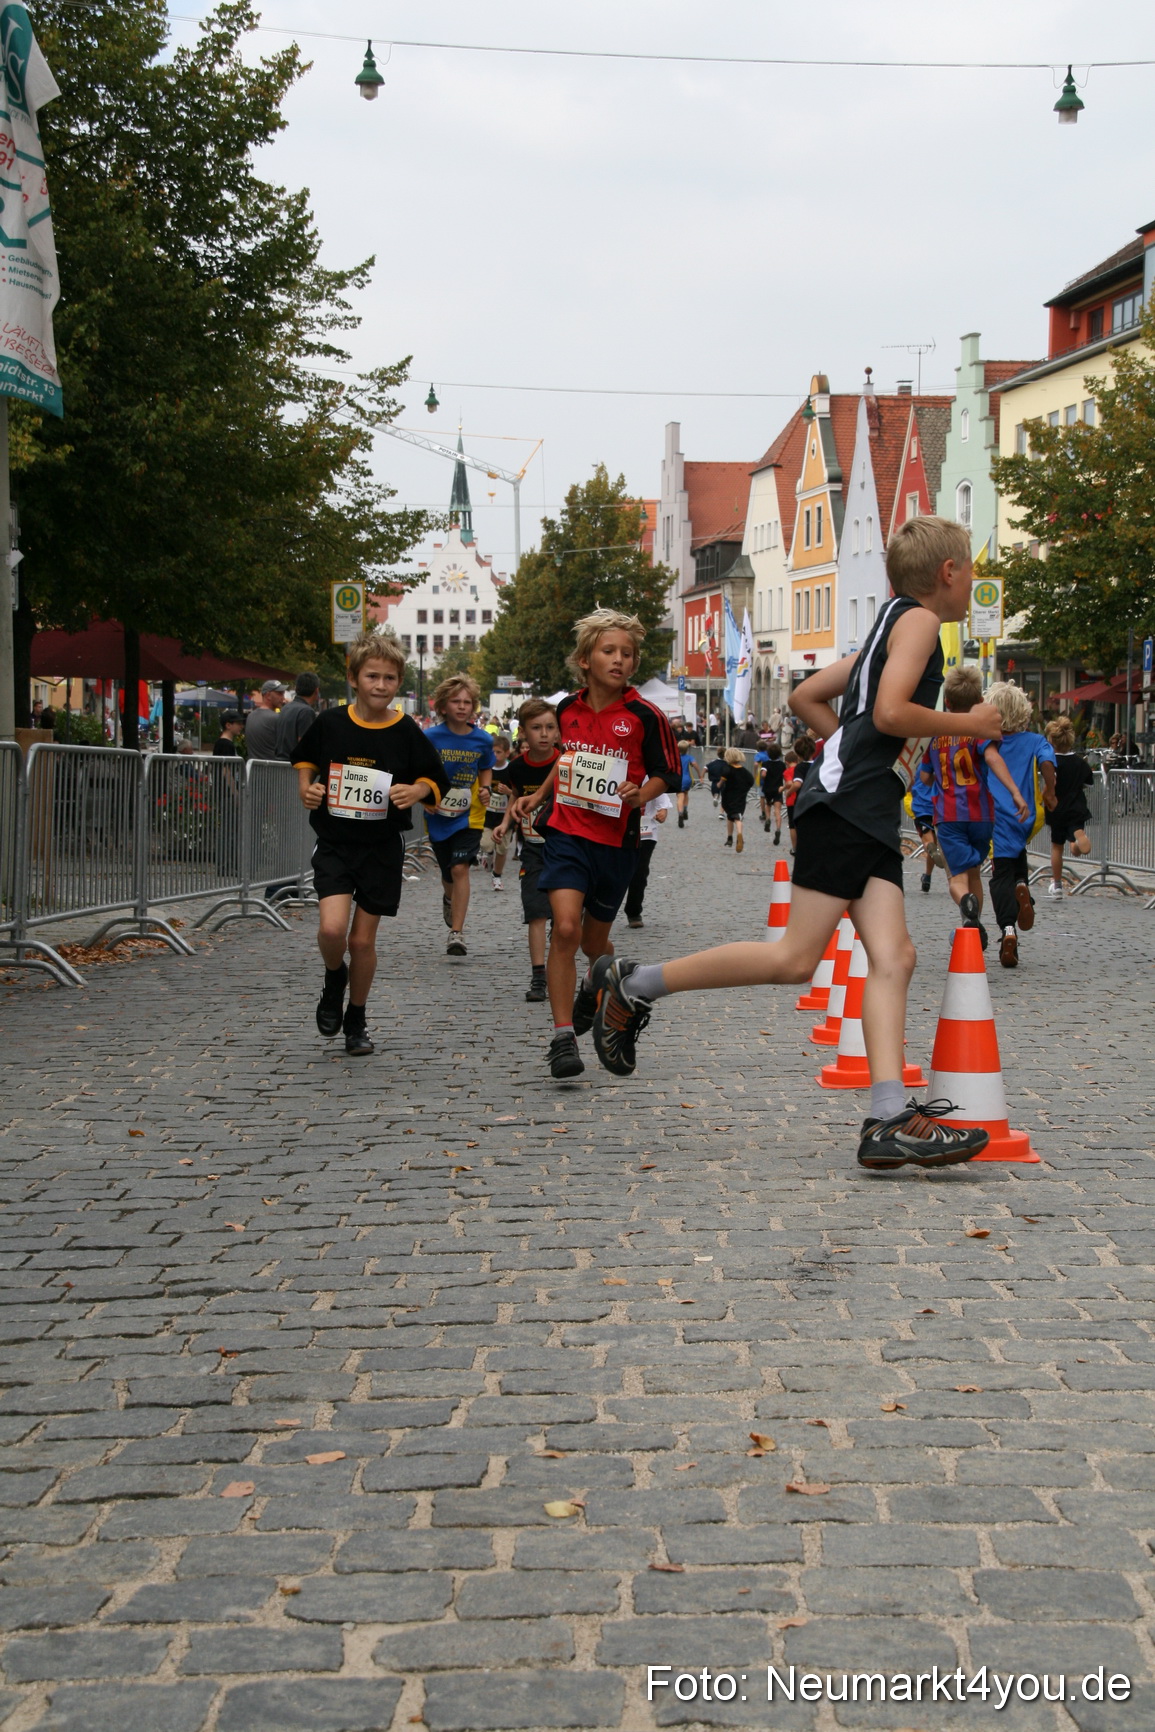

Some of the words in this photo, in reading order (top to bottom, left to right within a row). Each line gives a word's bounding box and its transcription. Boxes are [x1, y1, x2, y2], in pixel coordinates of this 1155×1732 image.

[43, 383, 56, 397] 13
[342, 592, 354, 606] H
[981, 588, 992, 601] H
[614, 725, 629, 733] FCN
[575, 755, 606, 771] Pascal
[939, 748, 977, 789] 10
[344, 770, 368, 782] Jonas
[575, 773, 618, 796] 7160
[344, 786, 383, 805] 7186
[443, 796, 468, 808] 7249
